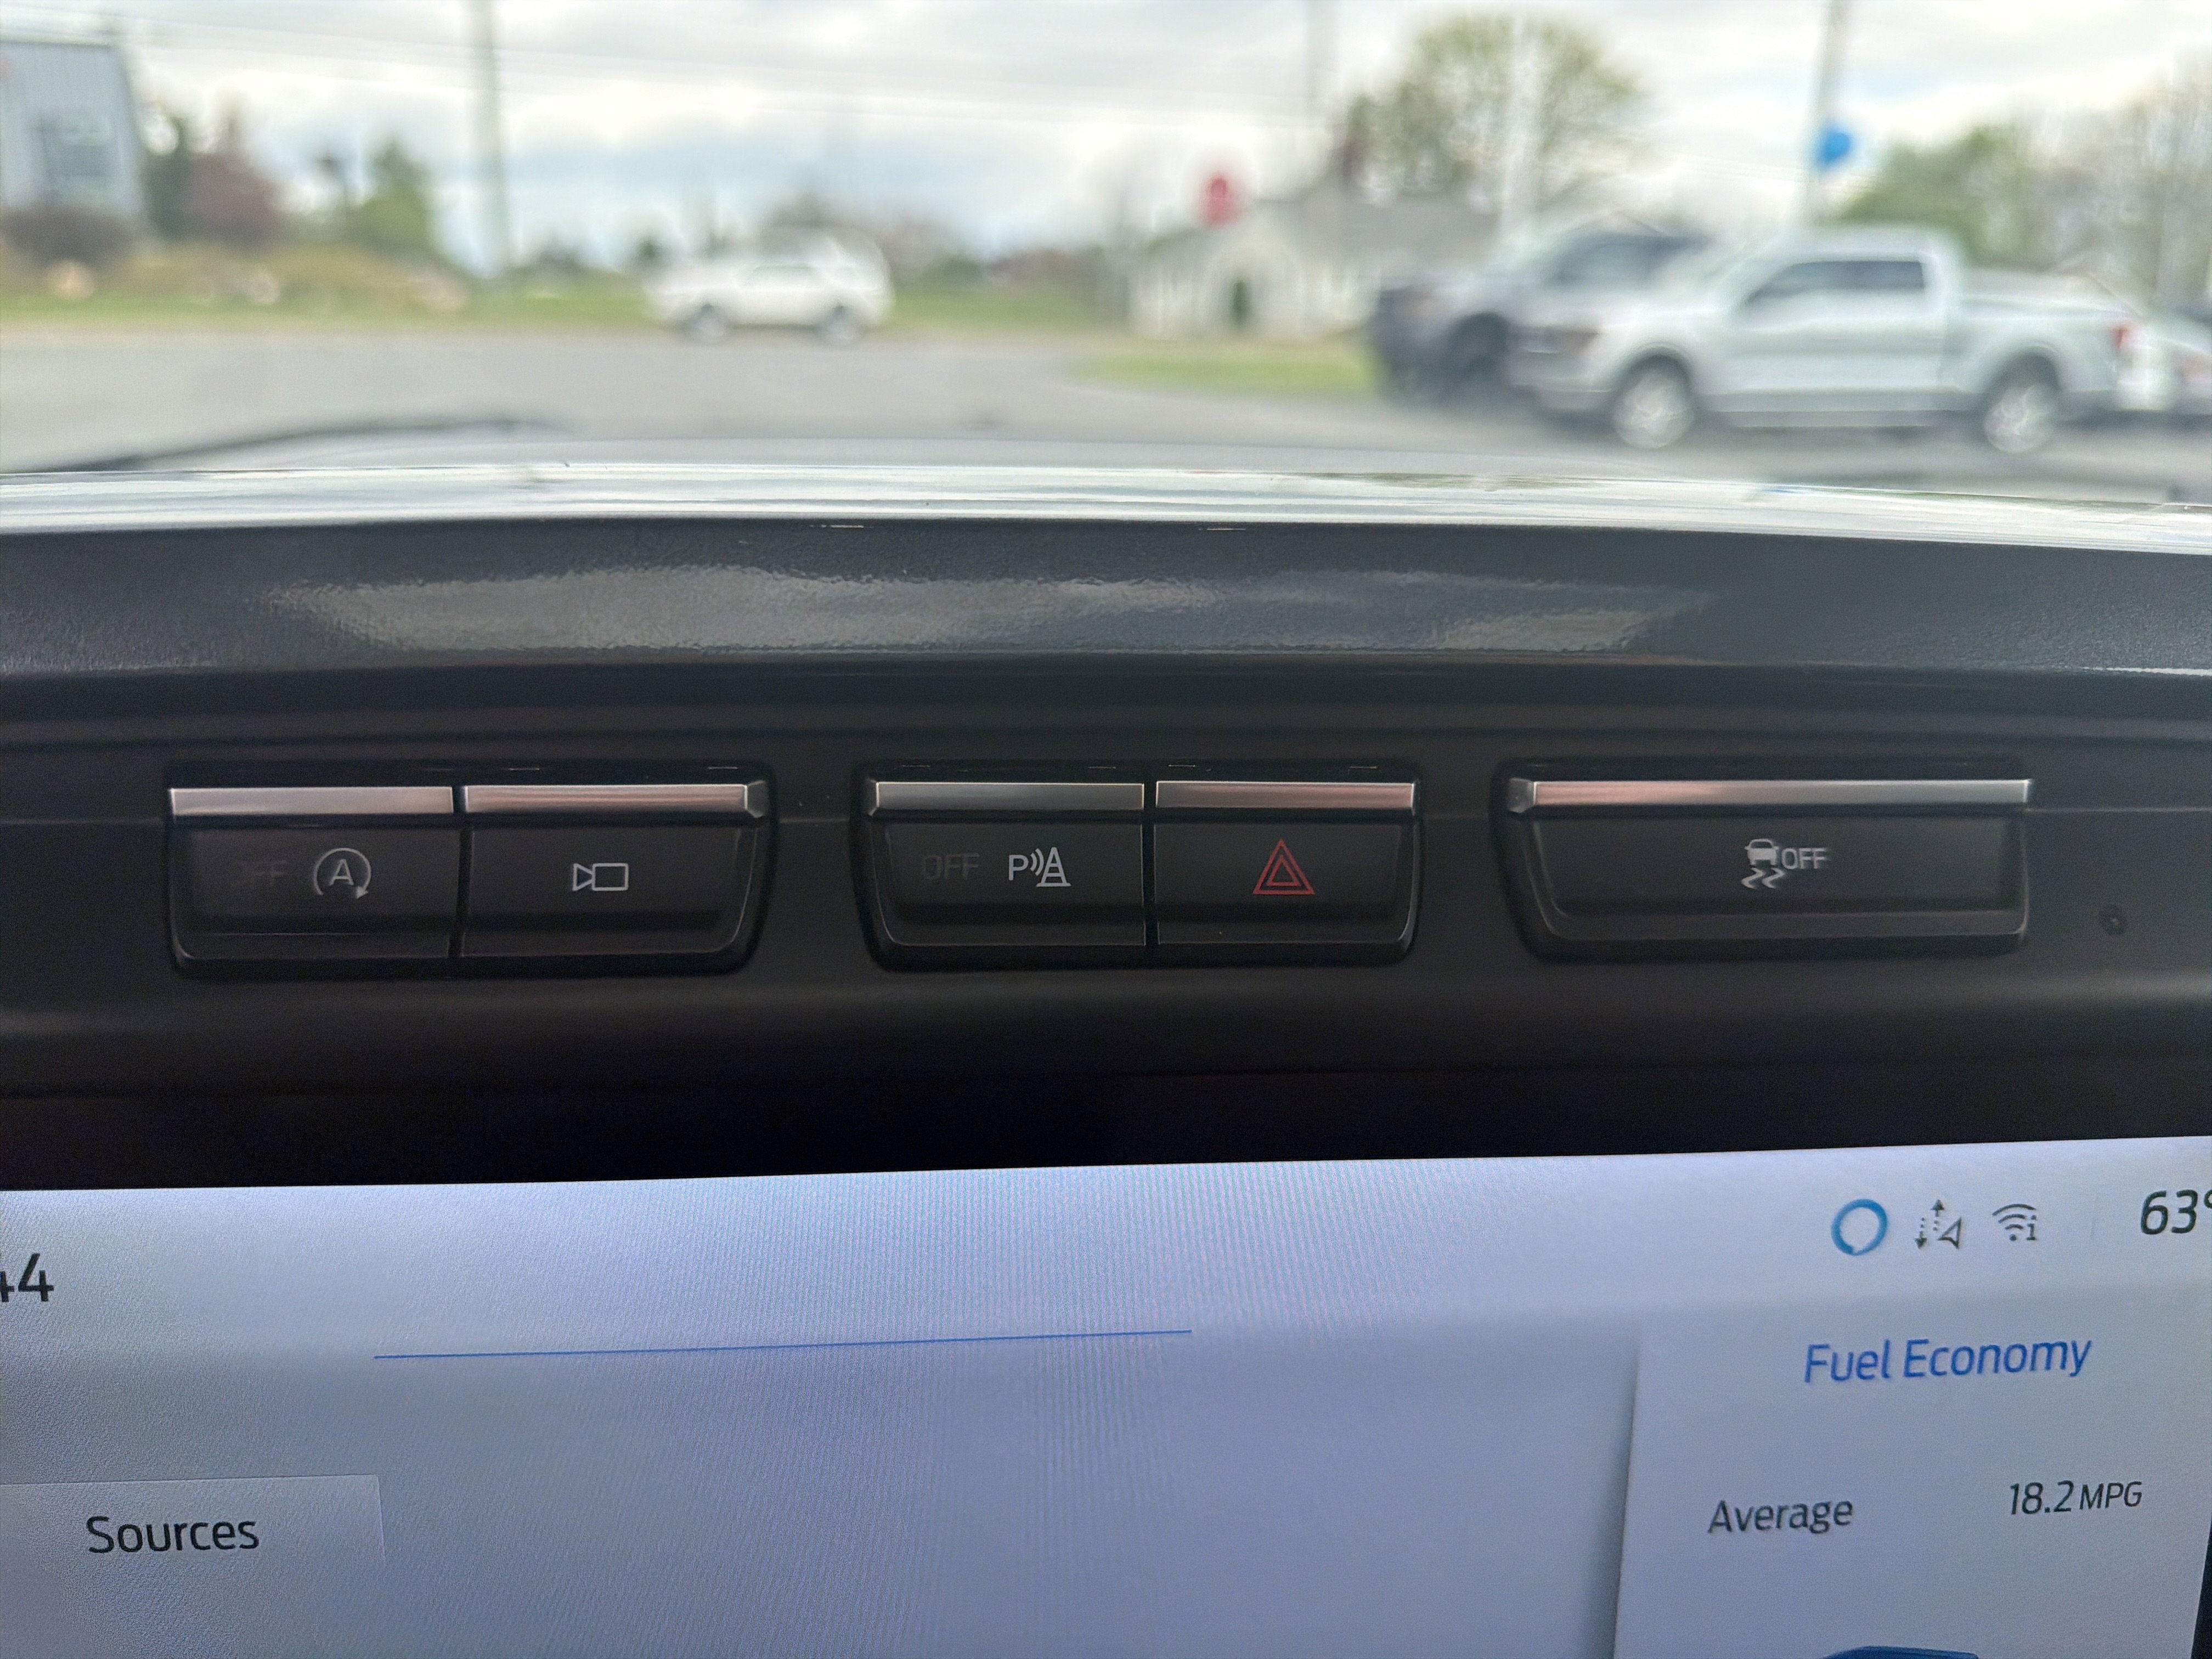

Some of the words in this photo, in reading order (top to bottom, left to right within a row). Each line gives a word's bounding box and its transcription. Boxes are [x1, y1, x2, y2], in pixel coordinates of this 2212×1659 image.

[921, 853, 980, 881] OFF
[1782, 848, 1826, 870] OFF
[1804, 1339, 1892, 1384] Fuel
[1902, 1338, 2092, 1379] Economy
[2010, 1480, 2074, 1515] 18.2
[2079, 1481, 2142, 1510] MPG
[1707, 1499, 1853, 1534] Average
[86, 1515, 260, 1554] Sources
